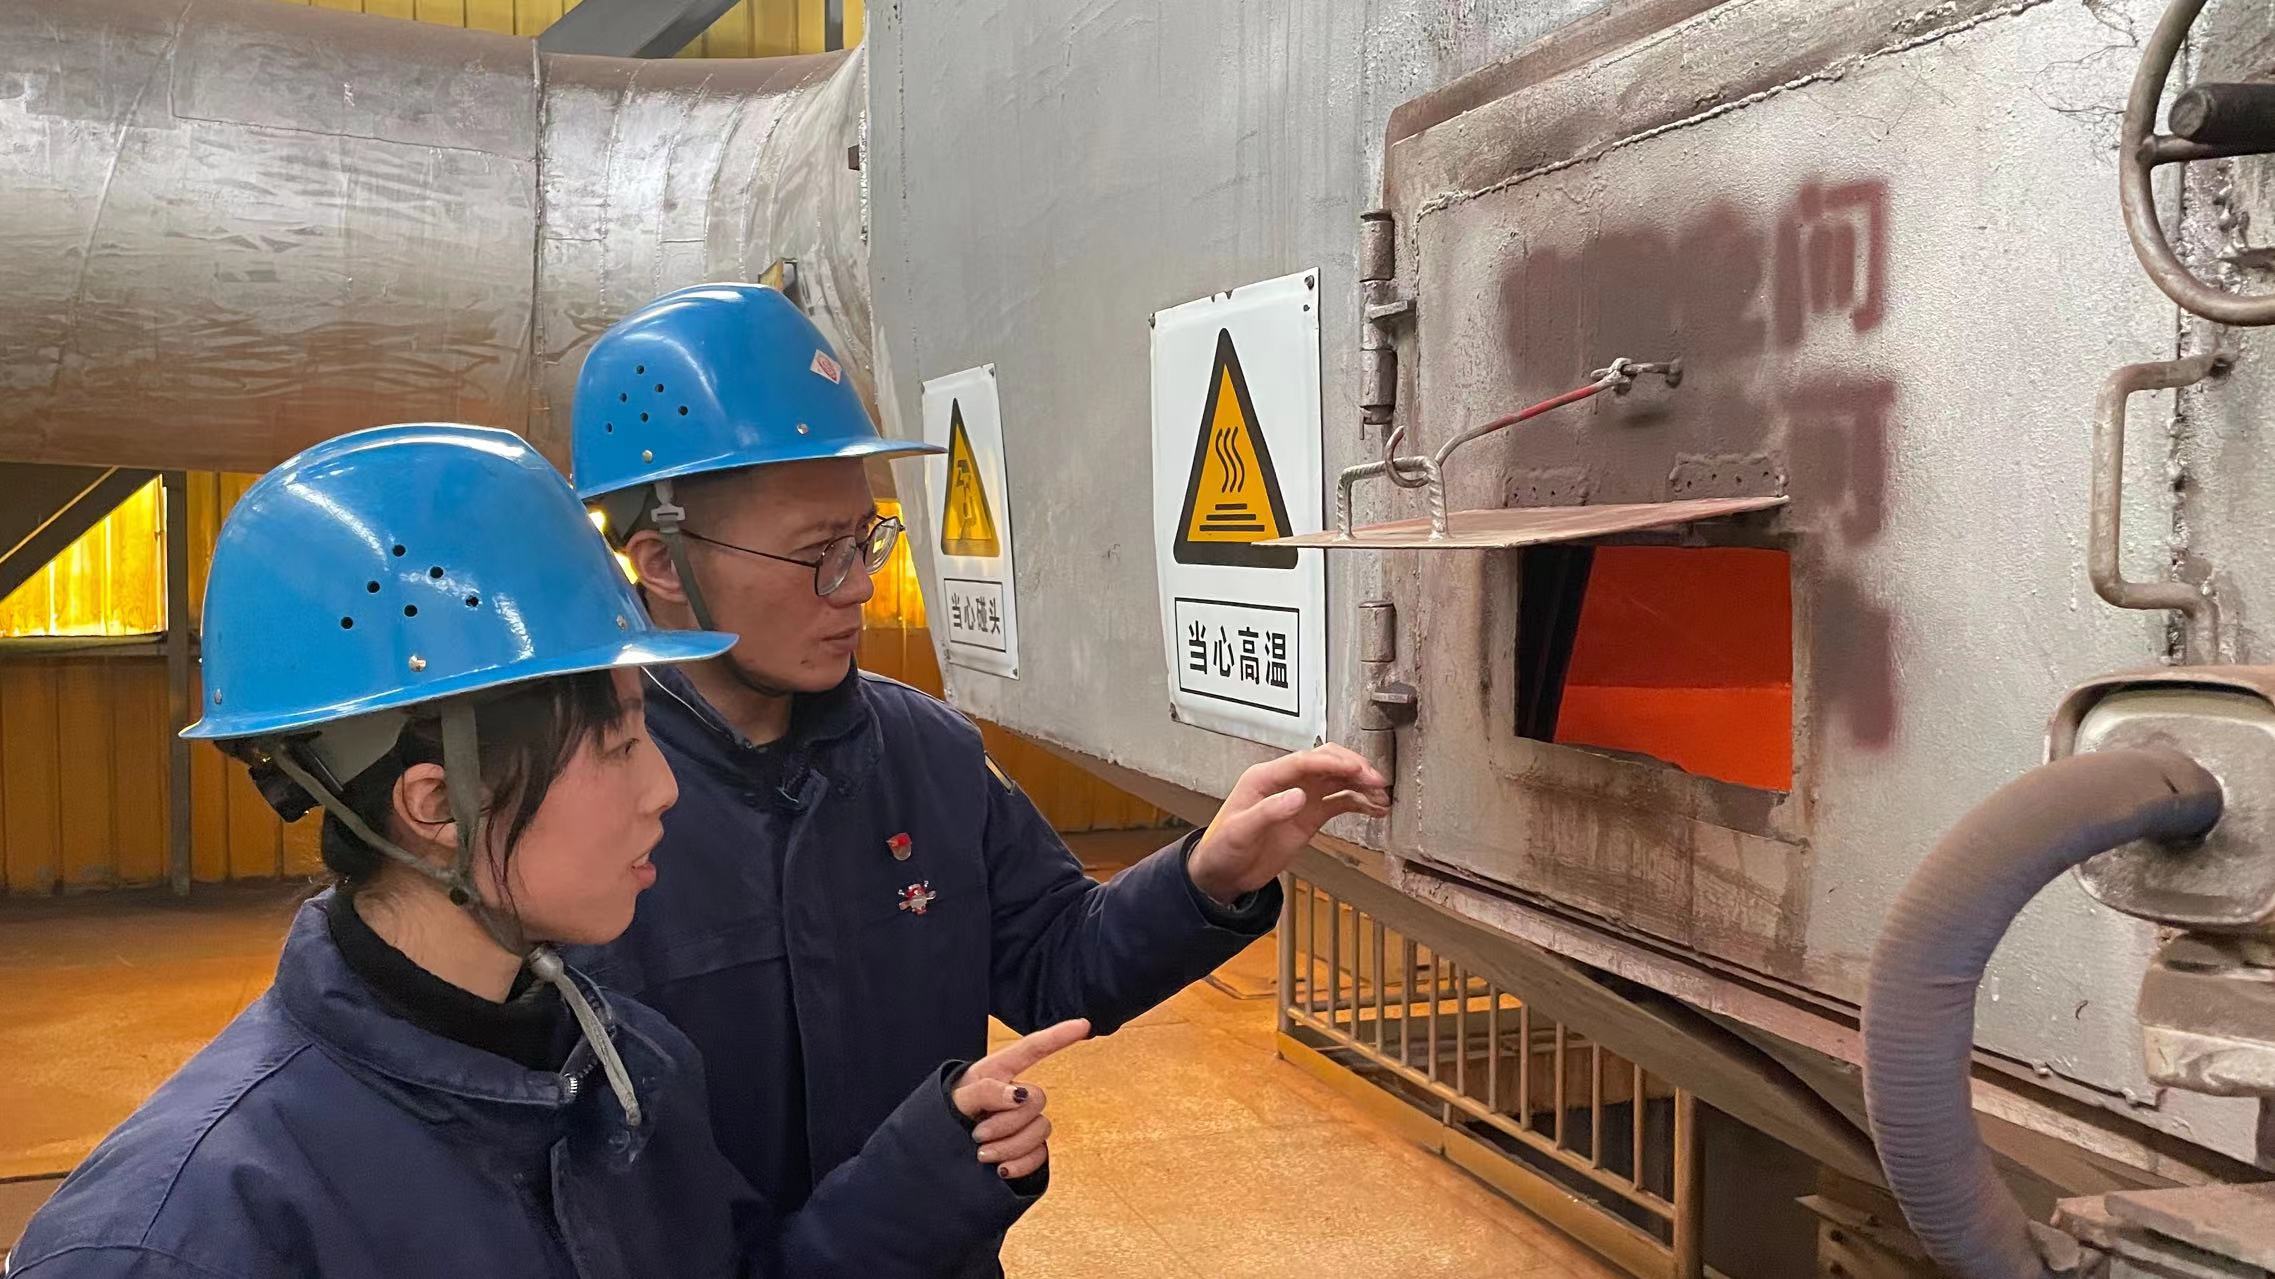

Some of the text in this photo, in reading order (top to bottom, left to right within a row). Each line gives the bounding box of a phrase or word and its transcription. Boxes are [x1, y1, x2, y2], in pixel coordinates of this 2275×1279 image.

[951, 592, 1001, 635] 当心碰头
[1188, 619, 1289, 689] 当心高温
